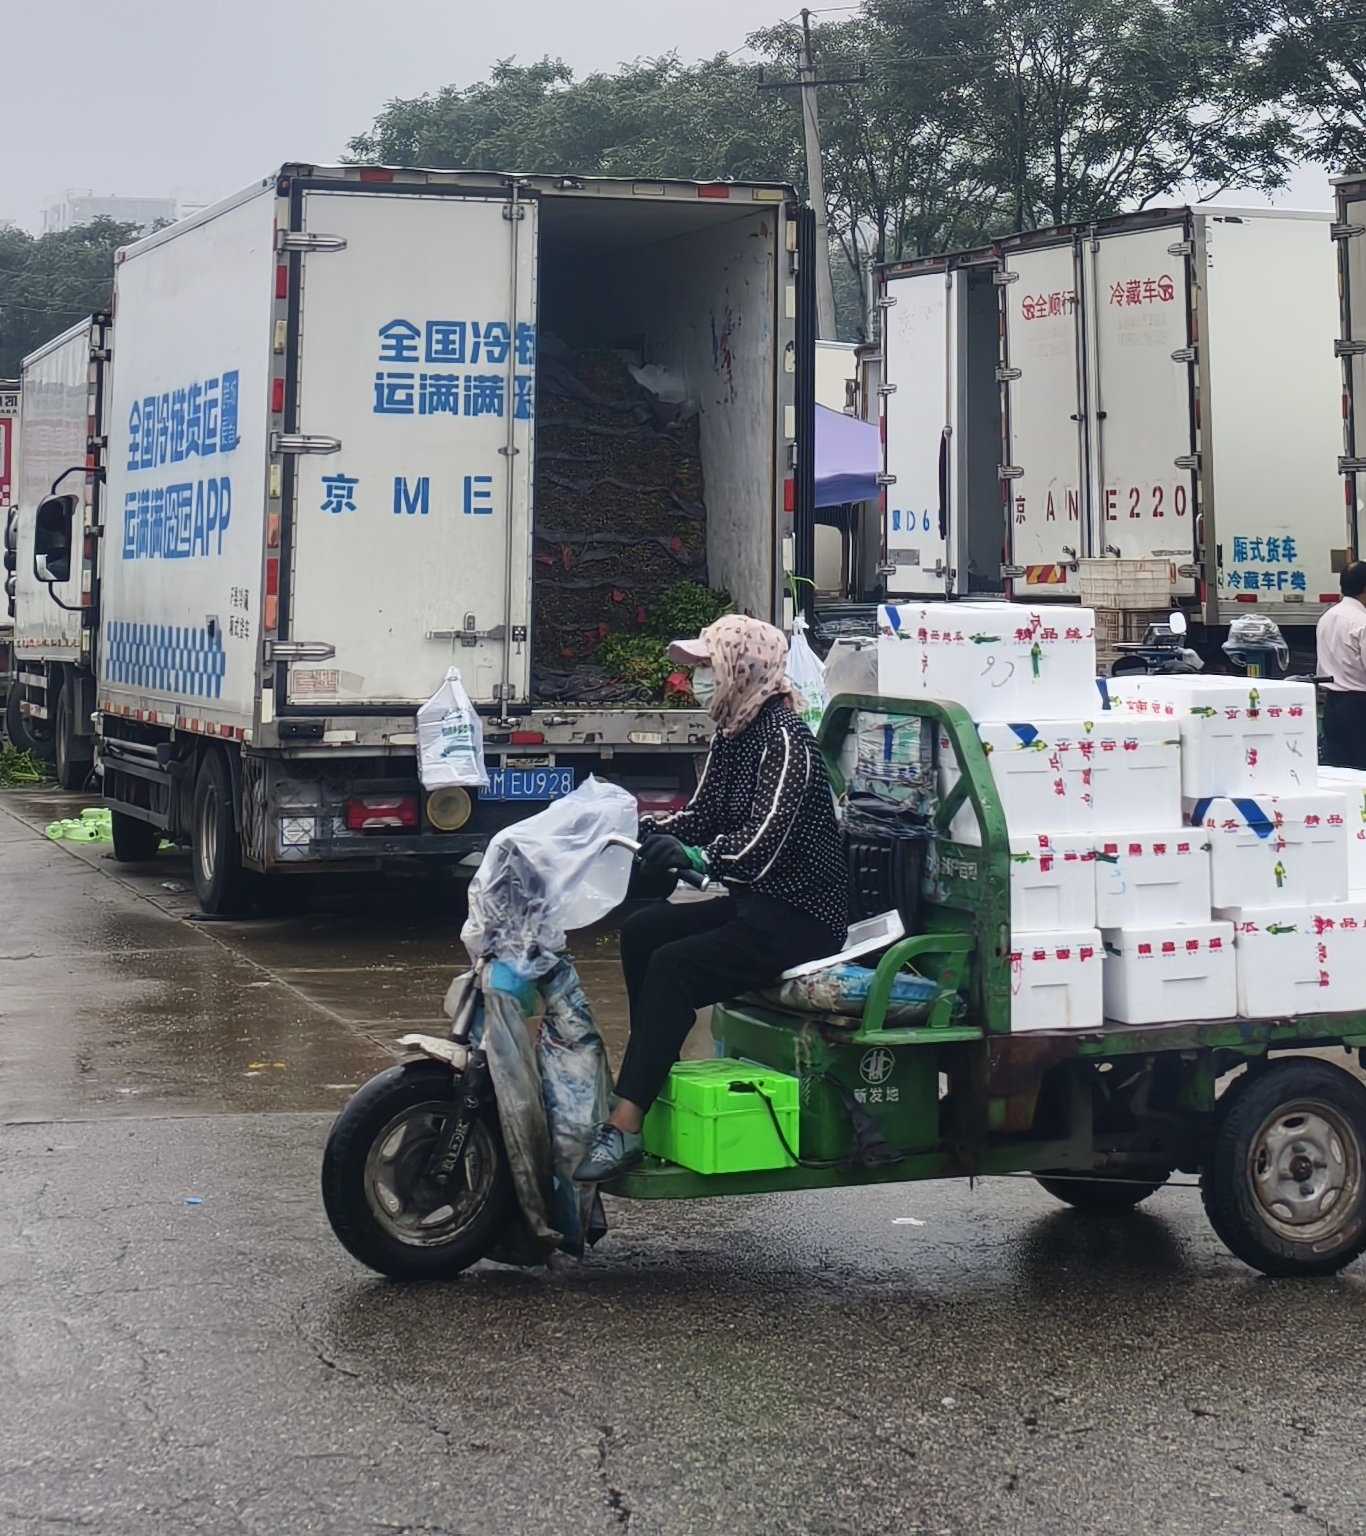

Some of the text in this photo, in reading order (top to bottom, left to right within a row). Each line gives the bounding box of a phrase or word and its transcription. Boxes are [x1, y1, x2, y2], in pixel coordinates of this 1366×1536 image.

[1109, 277, 1160, 307] 冷藏车
[1233, 535, 1298, 563] 厢式货车
[1227, 570, 1307, 591] 冷藏车F类
